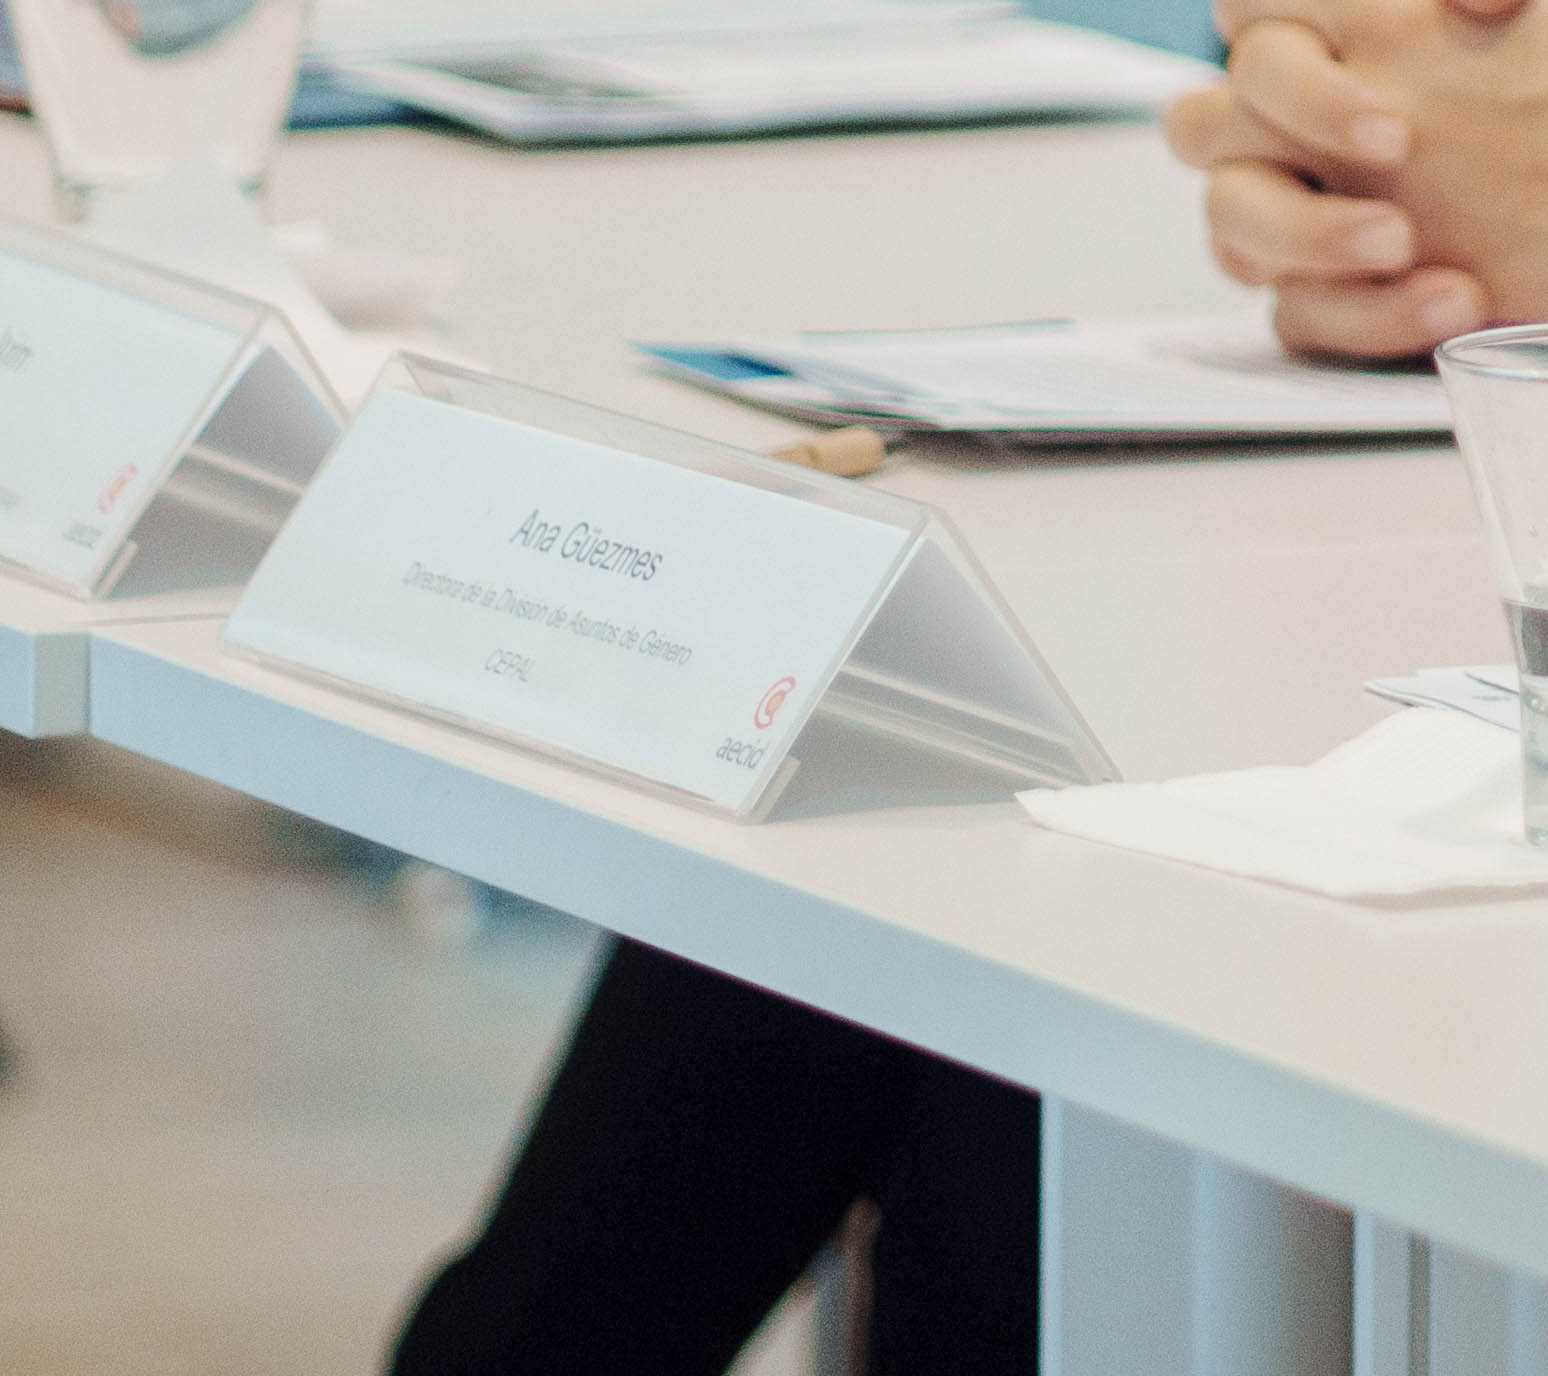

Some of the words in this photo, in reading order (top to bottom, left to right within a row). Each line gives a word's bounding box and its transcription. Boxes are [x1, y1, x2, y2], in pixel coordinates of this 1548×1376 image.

[509, 508, 561, 553] Ana
[560, 521, 663, 581] Güezmes
[546, 603, 569, 629] de
[617, 624, 641, 650] de
[638, 628, 693, 666] Género
[715, 735, 771, 770] aecid
